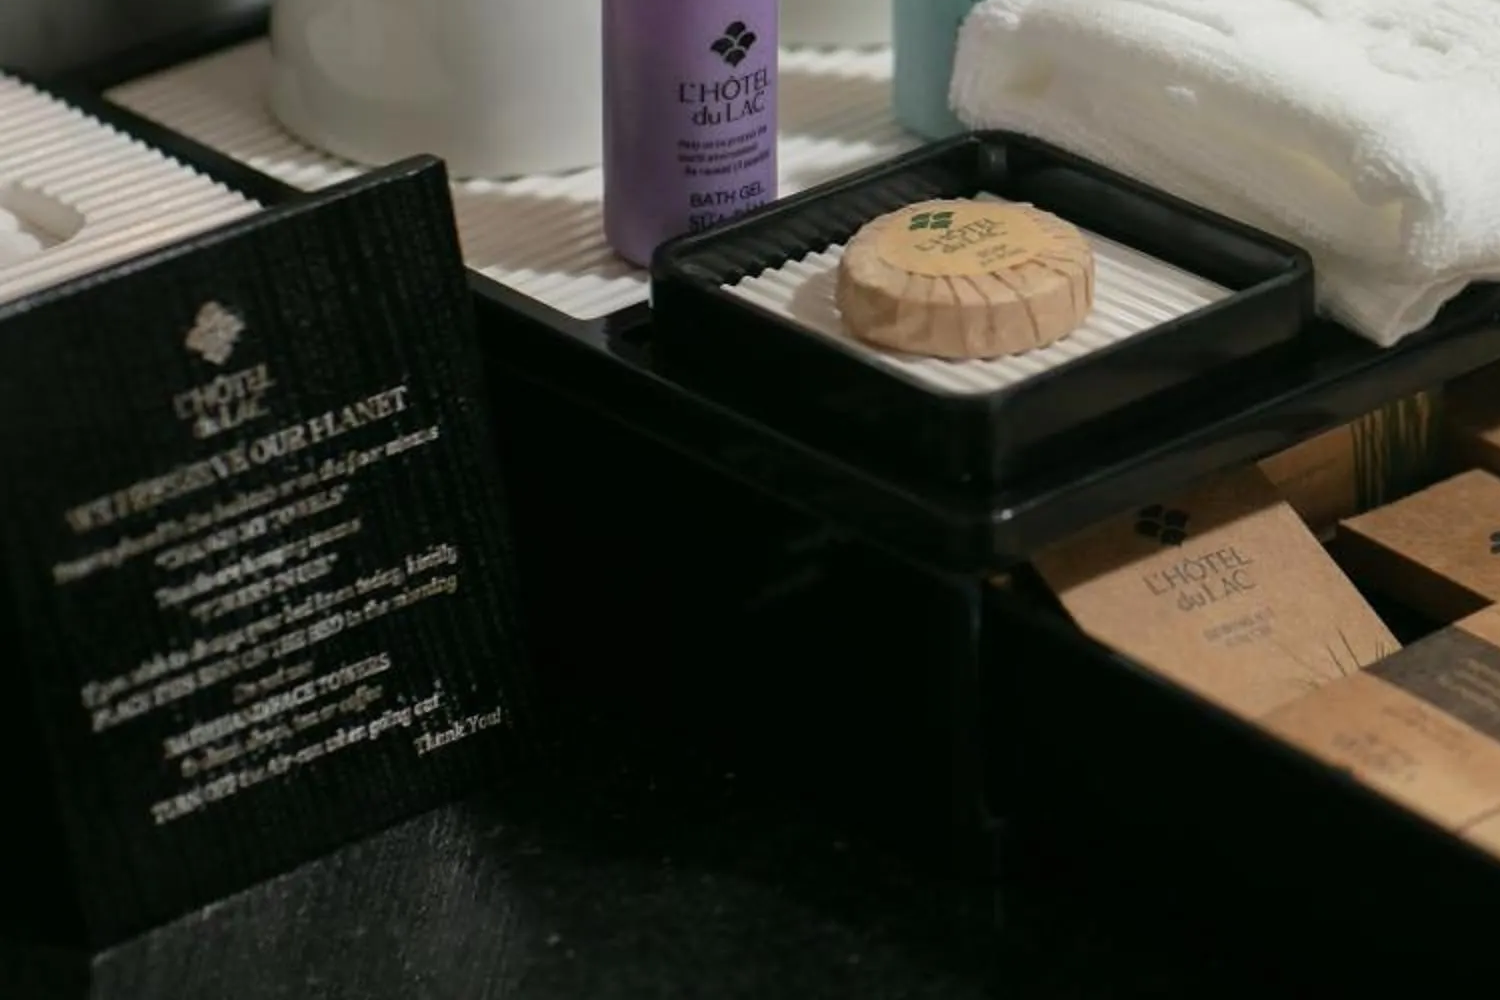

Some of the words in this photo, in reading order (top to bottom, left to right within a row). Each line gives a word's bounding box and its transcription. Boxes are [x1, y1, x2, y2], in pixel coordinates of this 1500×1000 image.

[678, 68, 770, 104] L'HÔTEL
[692, 107, 721, 126] du
[726, 91, 766, 123] LAC
[689, 190, 737, 209] BATH
[740, 181, 767, 200] GEL
[247, 423, 308, 465] OUR
[307, 384, 410, 442] PLANET
[1142, 546, 1254, 596] L'HÔTEL
[1177, 590, 1207, 612] du
[1202, 568, 1258, 602] LAC
